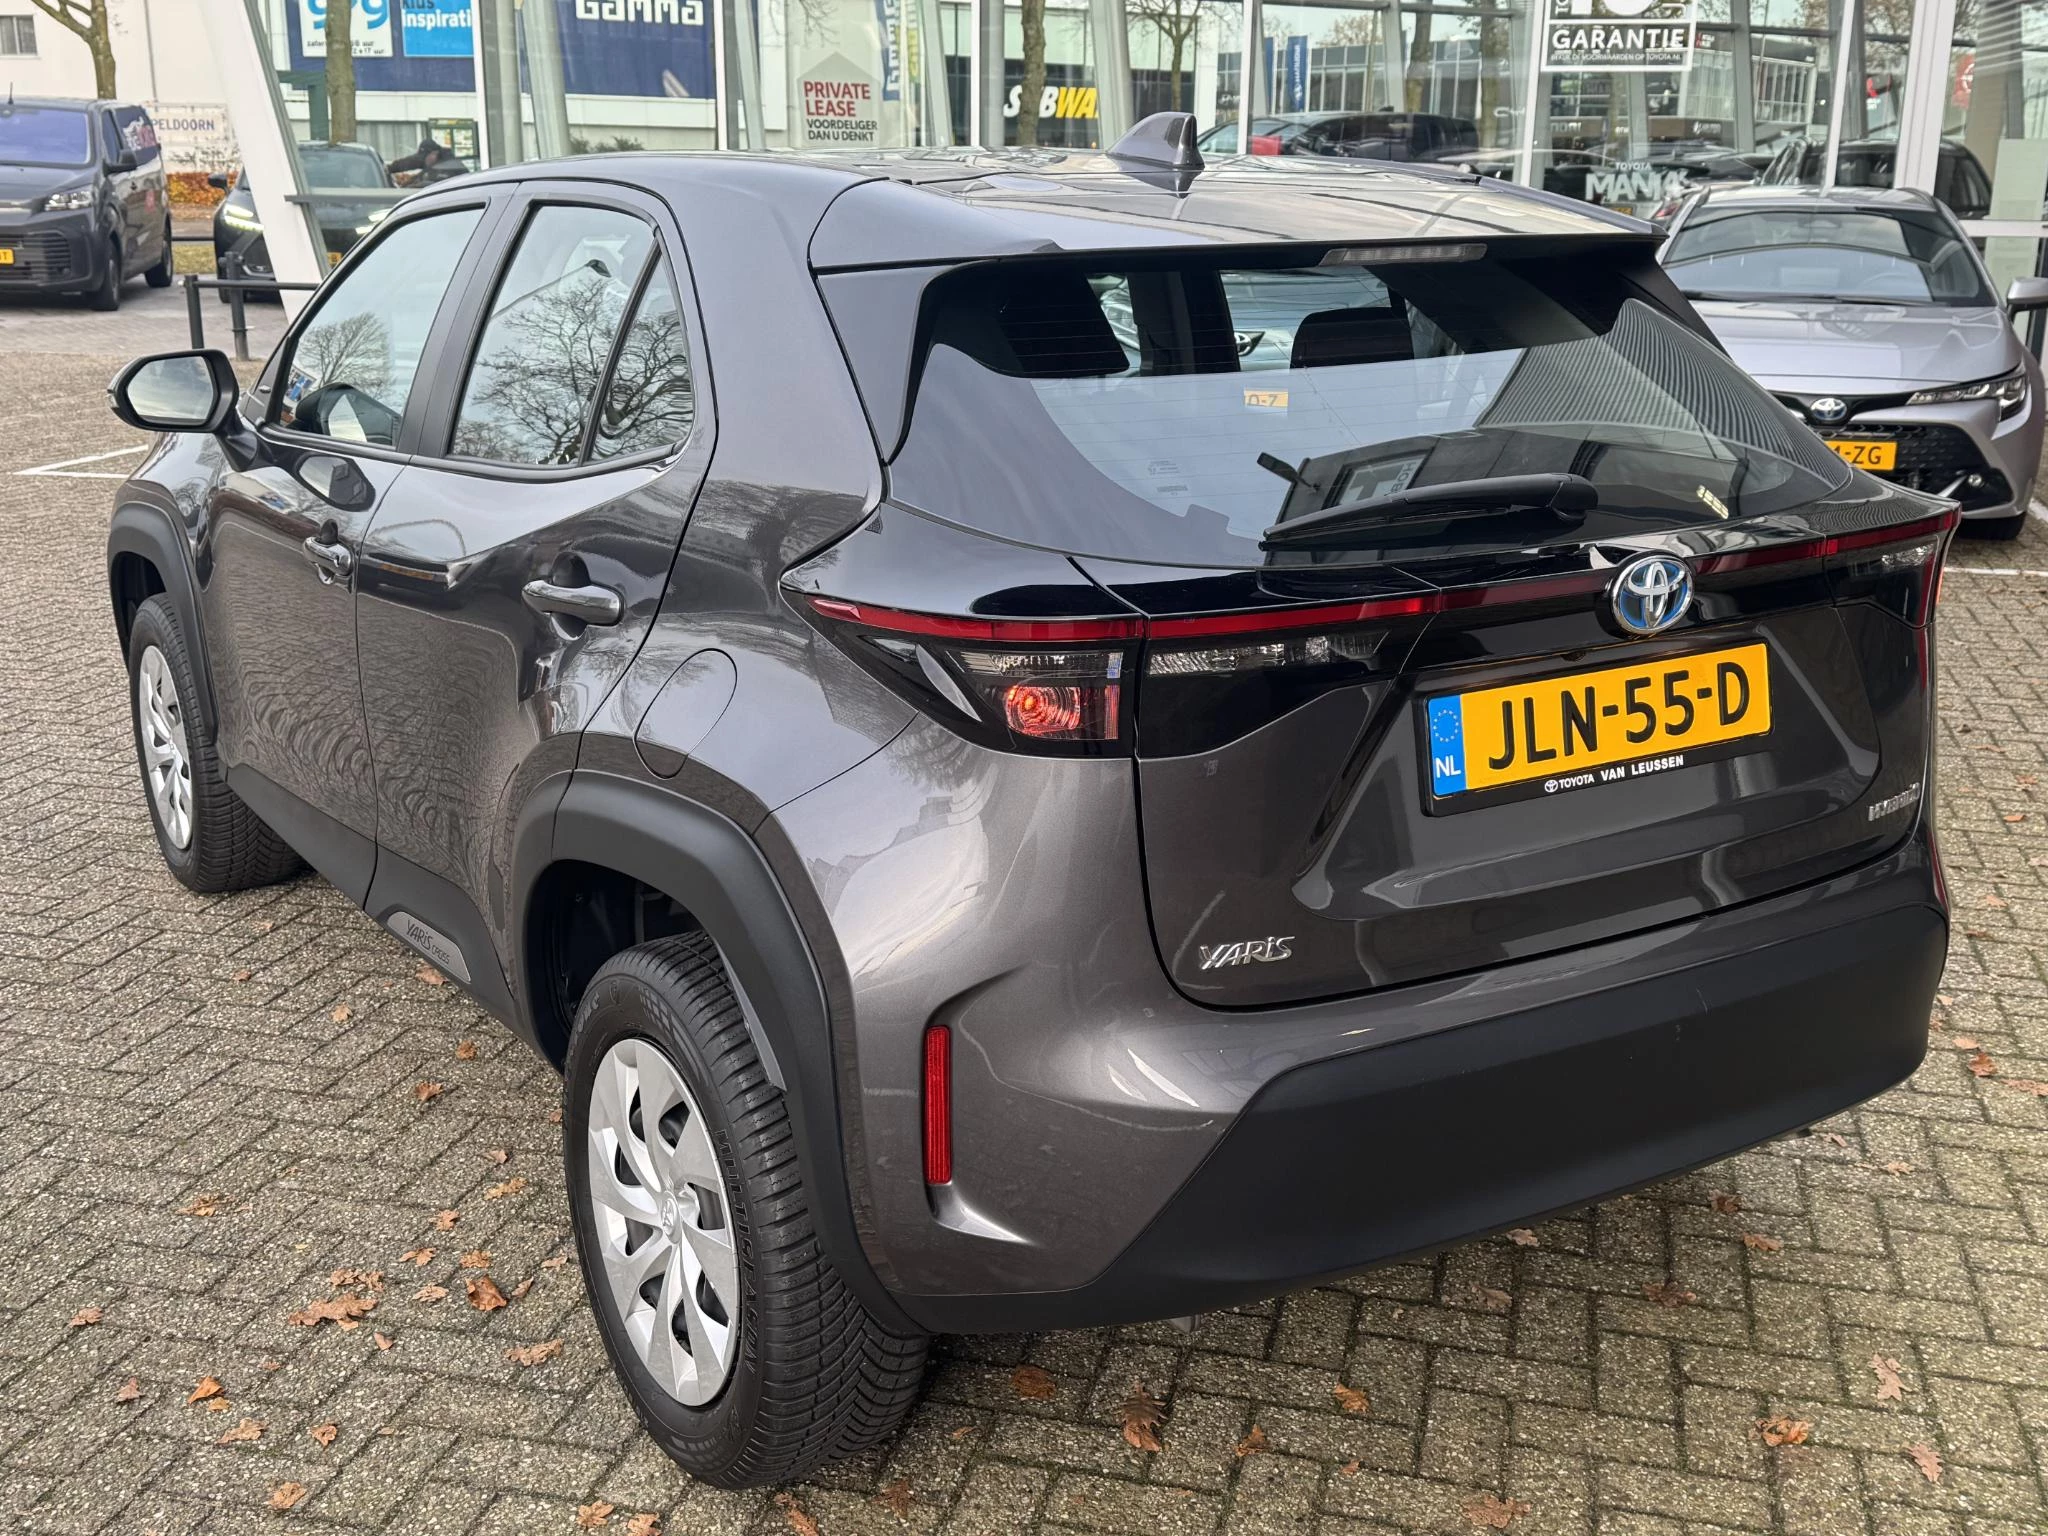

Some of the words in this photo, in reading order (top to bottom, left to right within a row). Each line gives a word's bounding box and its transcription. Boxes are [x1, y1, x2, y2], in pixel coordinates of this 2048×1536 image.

[1552, 28, 1684, 49] GARANTIE
[804, 81, 871, 99] PRIVATE
[806, 99, 856, 117] LEASE
[806, 119, 878, 130] VOORDELIGER
[808, 130, 831, 140] DAN
[832, 131, 840, 140] U
[841, 131, 874, 141] DENKT
[1615, 162, 1653, 171] TOYOTA
[1488, 661, 1751, 771] JLN-55-D
[1435, 755, 1461, 778] NL
[1559, 774, 1595, 790] TOYOTA
[1600, 766, 1625, 782] VAN
[1631, 754, 1684, 776] LEUSSEN
[1200, 936, 1296, 970] YARIS
